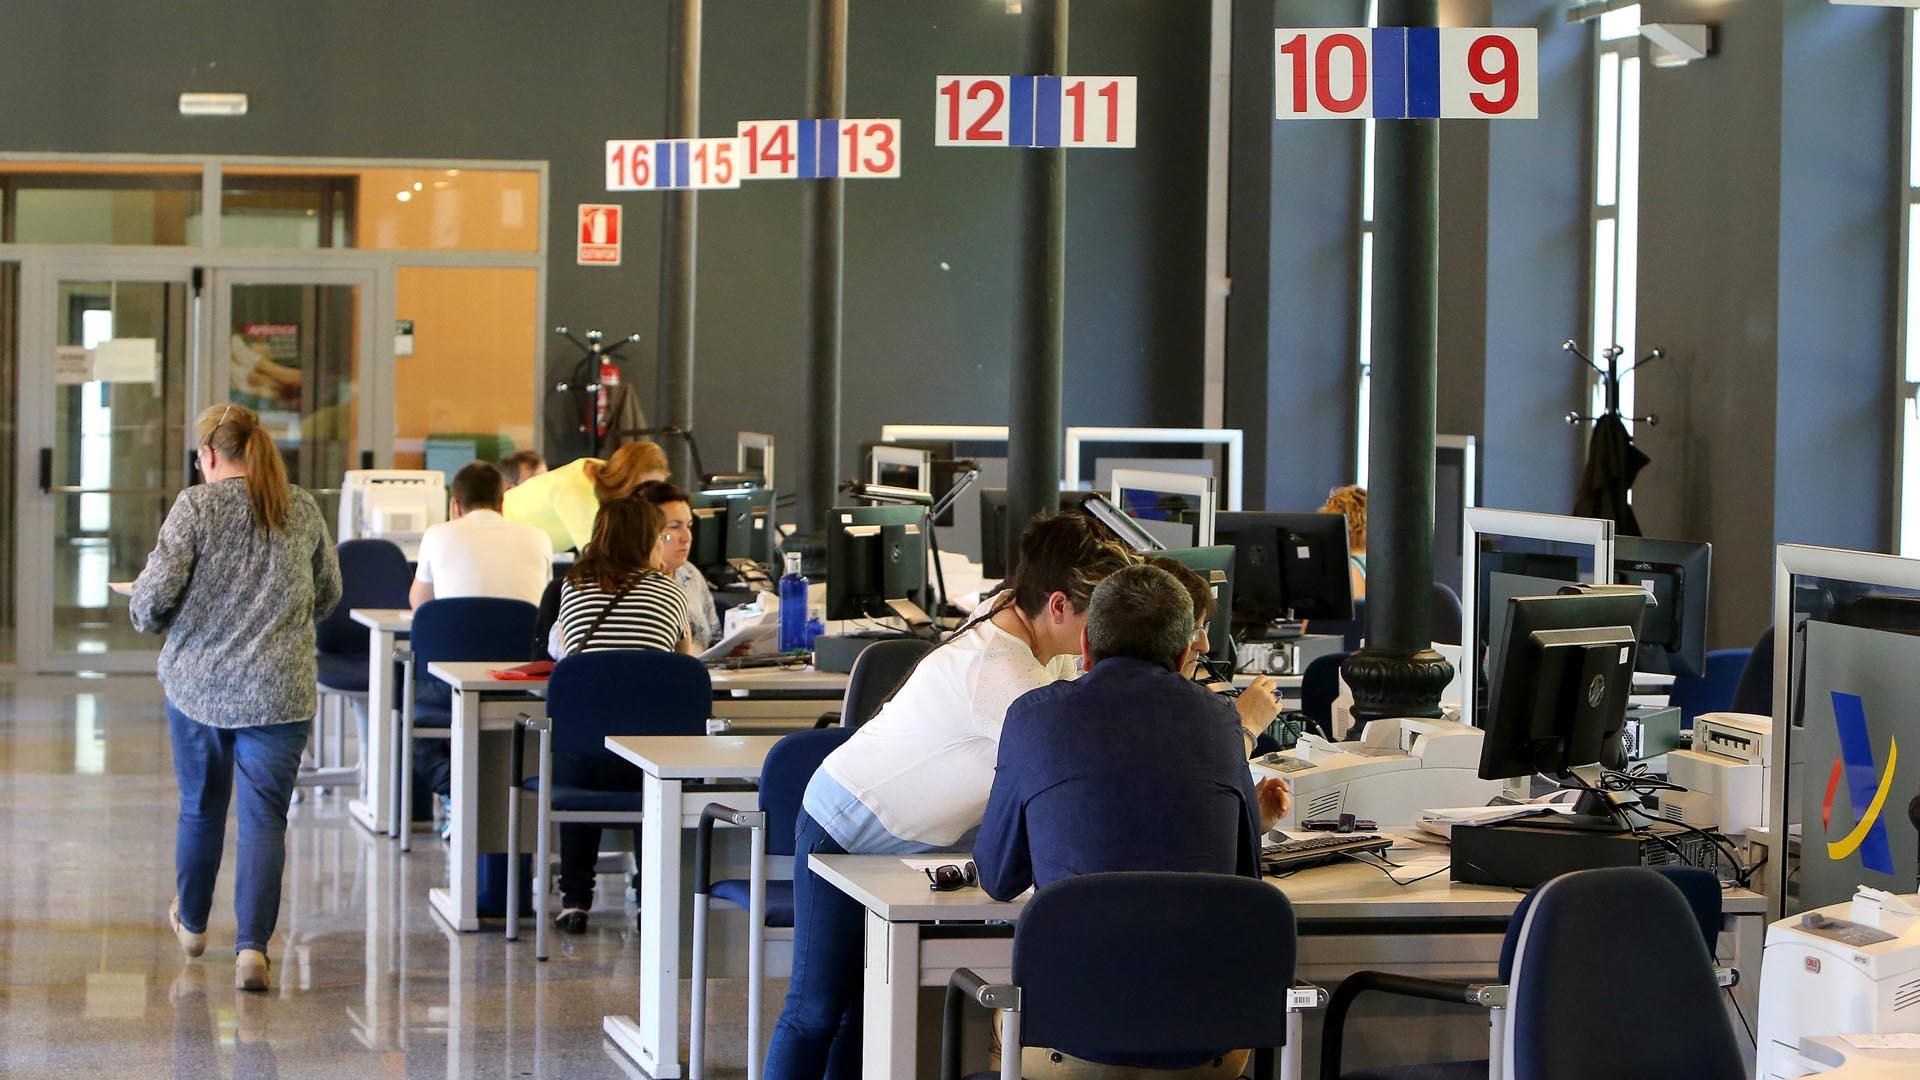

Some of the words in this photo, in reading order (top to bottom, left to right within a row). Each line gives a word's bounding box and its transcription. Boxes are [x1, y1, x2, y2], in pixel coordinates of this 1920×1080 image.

[1280, 33, 1367, 113] 10
[1468, 34, 1519, 115] 9
[940, 80, 1004, 140] 12
[1065, 81, 1118, 142] 11
[611, 145, 649, 186] 16
[695, 143, 732, 184] 15
[742, 124, 795, 174] 14
[842, 123, 895, 173] 13
